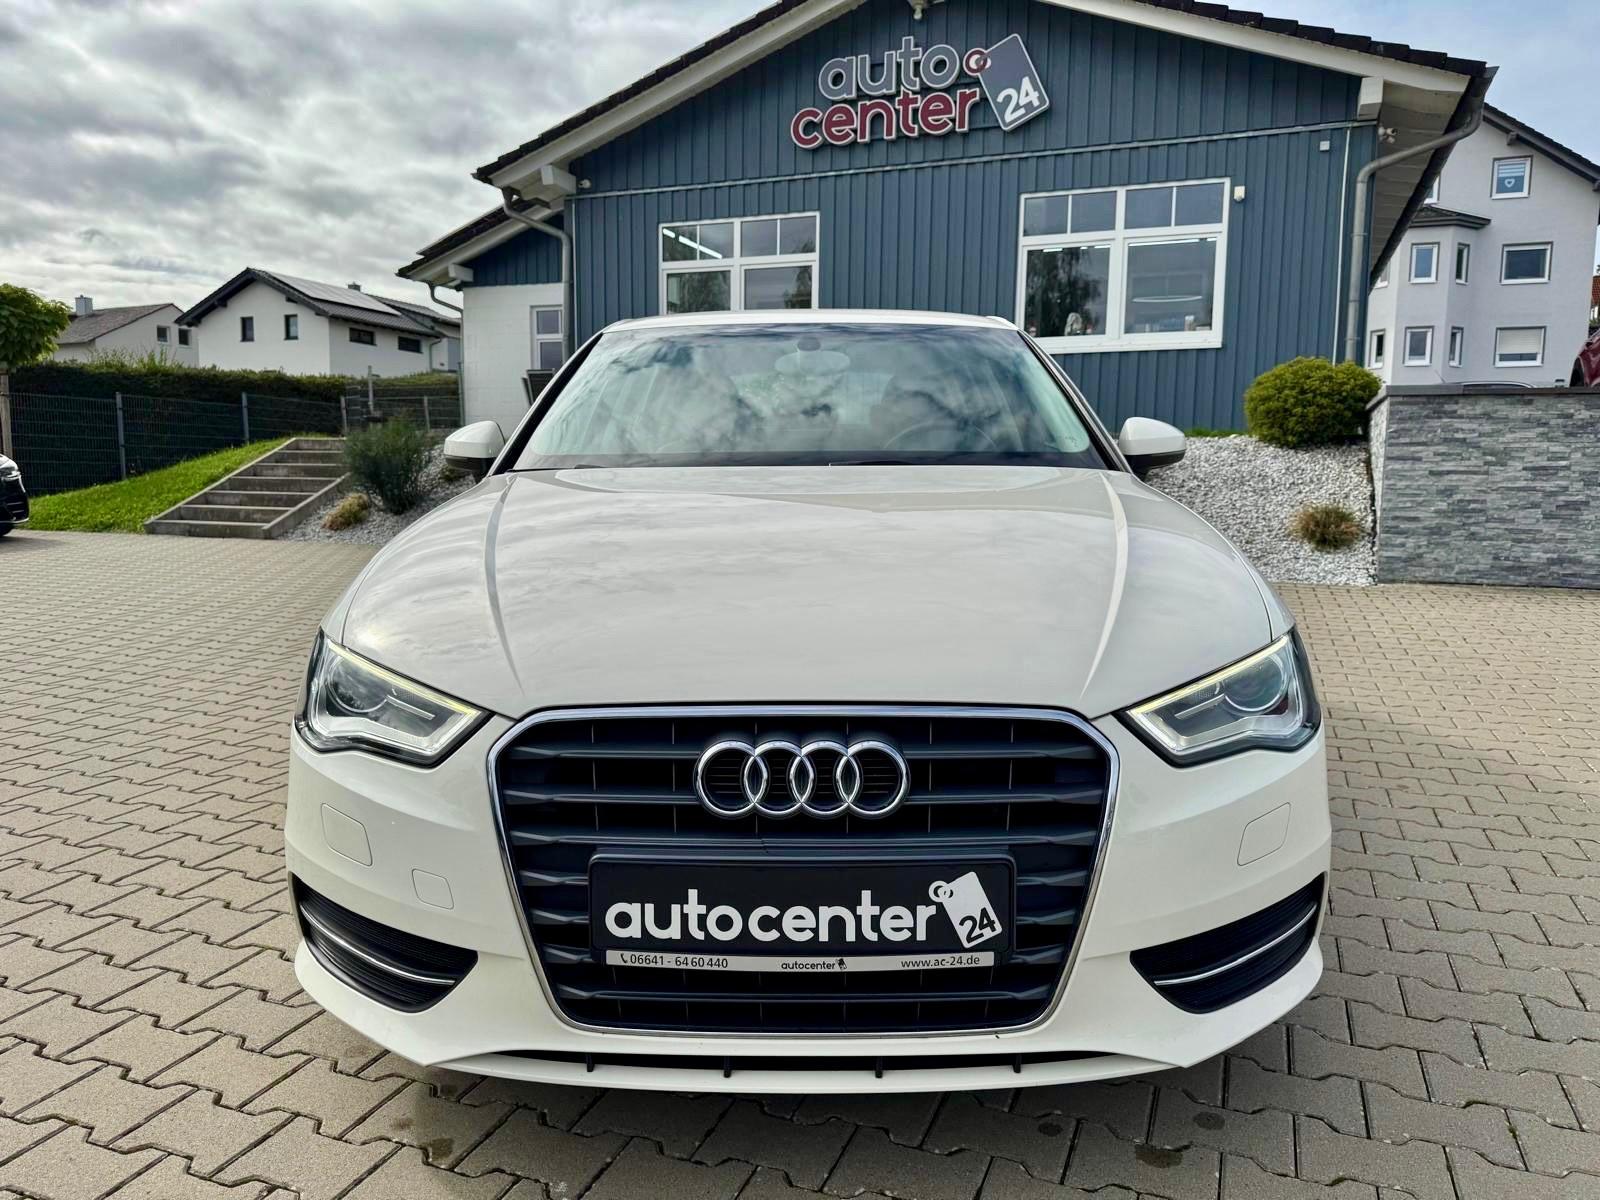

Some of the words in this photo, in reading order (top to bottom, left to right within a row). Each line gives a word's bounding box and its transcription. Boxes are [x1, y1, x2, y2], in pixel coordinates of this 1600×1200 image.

[818, 36, 960, 100] auto
[791, 87, 980, 149] center
[996, 76, 1041, 124] 24
[959, 907, 996, 943] 24
[781, 960, 836, 970] autocenter
[900, 955, 980, 969] www.ac-24.de
